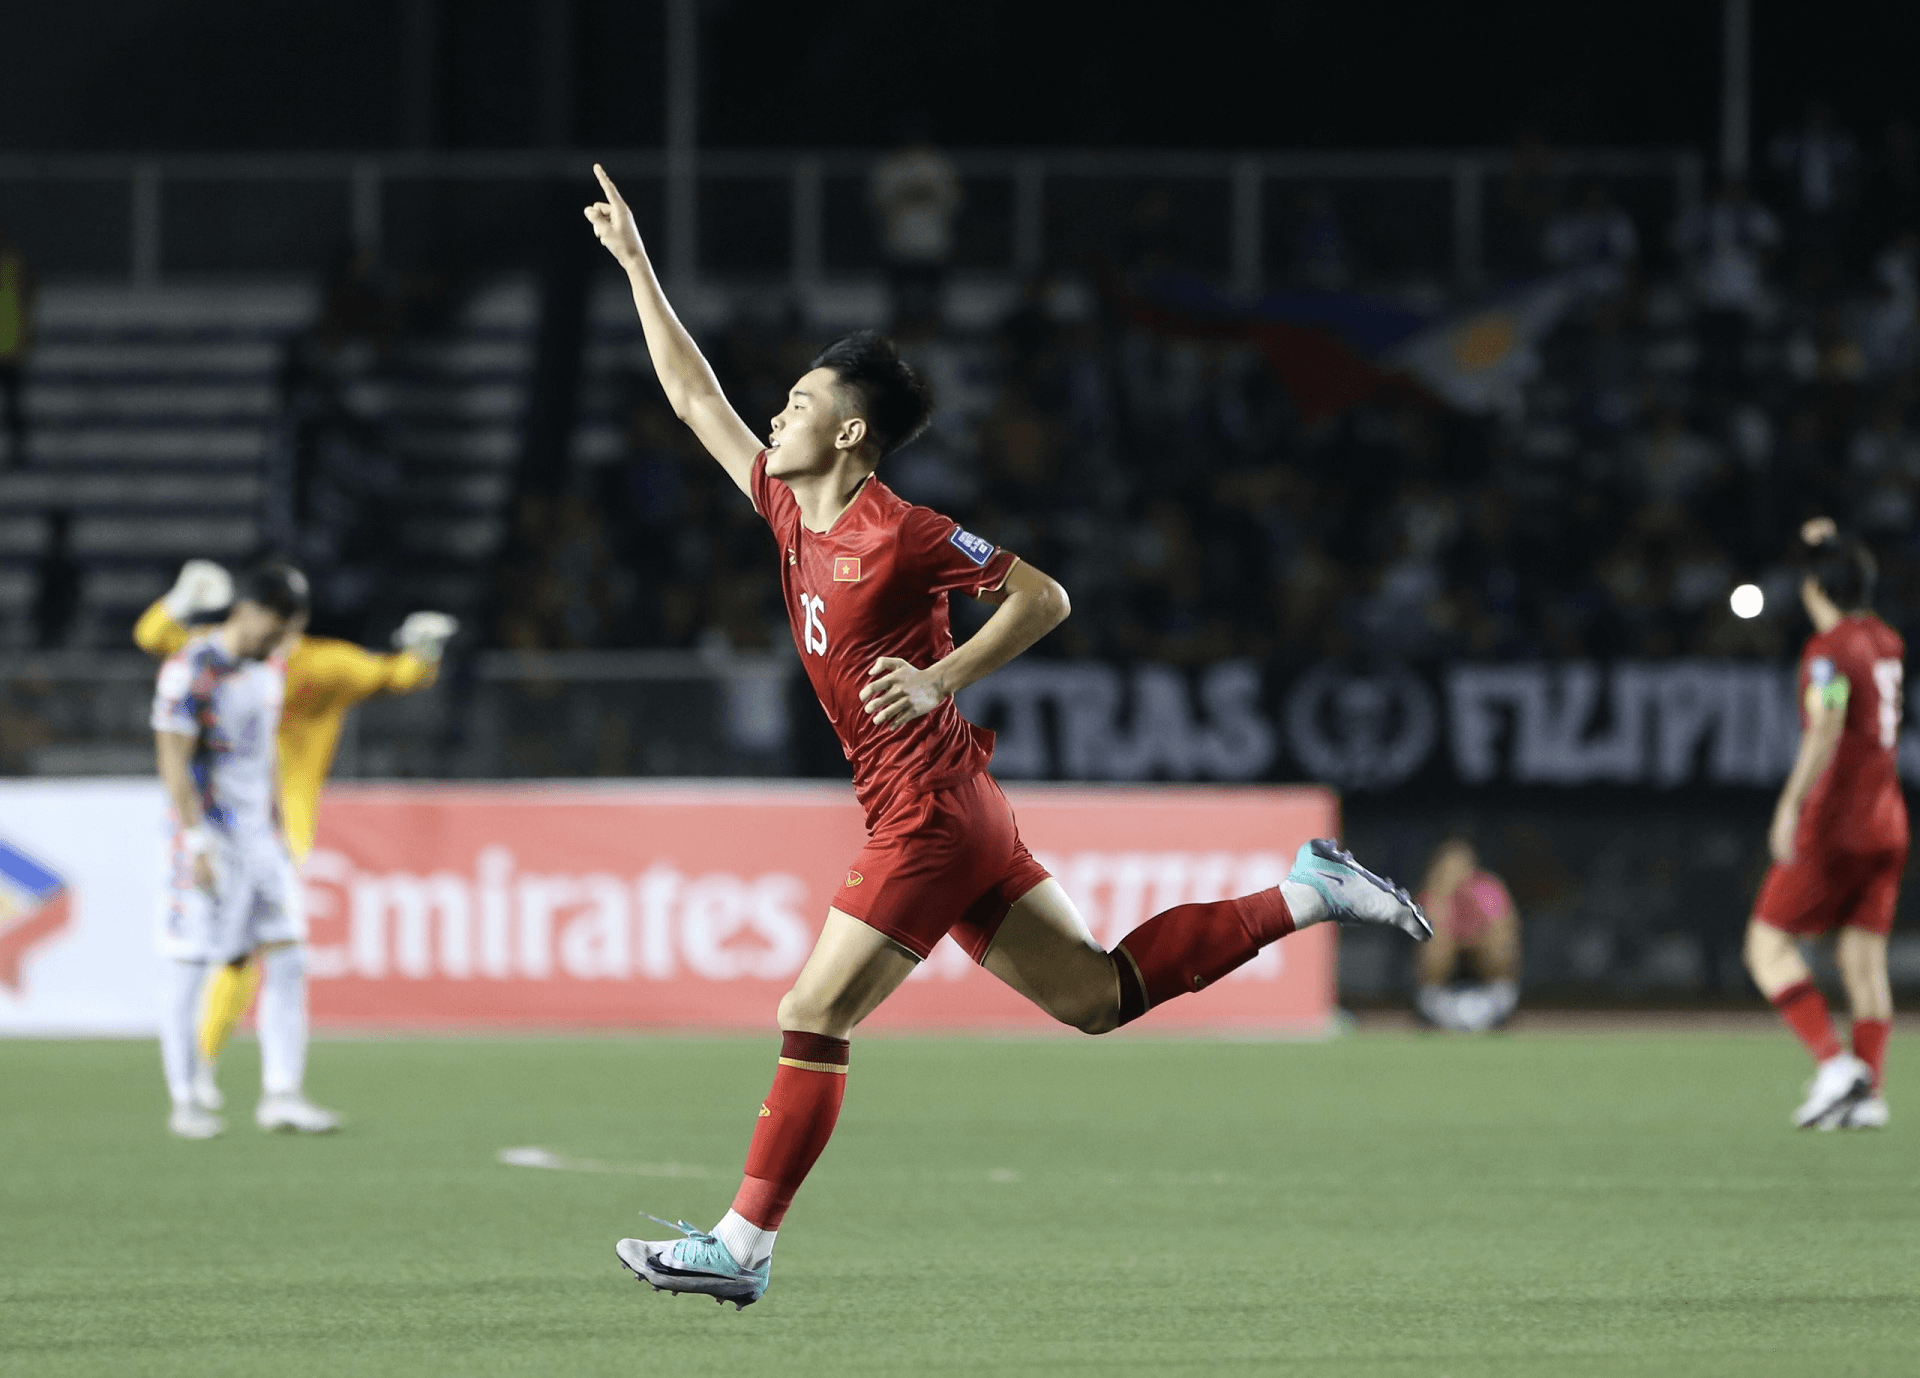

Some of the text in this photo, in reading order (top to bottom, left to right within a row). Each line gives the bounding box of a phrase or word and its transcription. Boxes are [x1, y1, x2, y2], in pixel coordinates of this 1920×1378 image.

[799, 591, 828, 657] 15
[957, 660, 1278, 778] TRAS
[302, 846, 812, 979] Emirates
